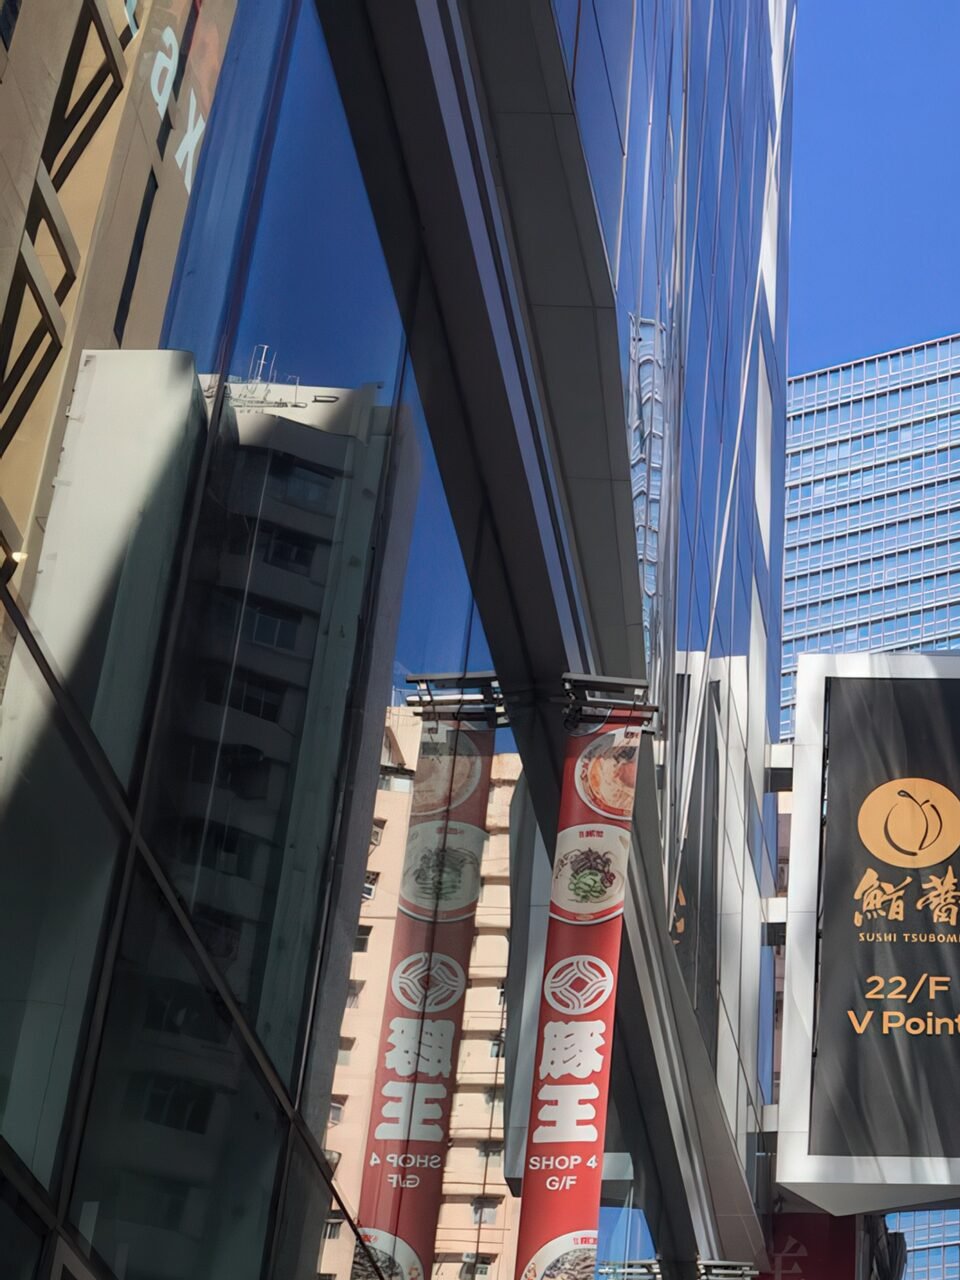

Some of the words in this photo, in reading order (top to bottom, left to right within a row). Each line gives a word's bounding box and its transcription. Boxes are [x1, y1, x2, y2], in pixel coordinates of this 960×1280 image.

[858, 932, 897, 944] SUSHI
[864, 973, 951, 1002] 22/F
[528, 1154, 582, 1171] SHOP
[585, 1153, 599, 1169] 4
[545, 1175, 578, 1191] G/F
